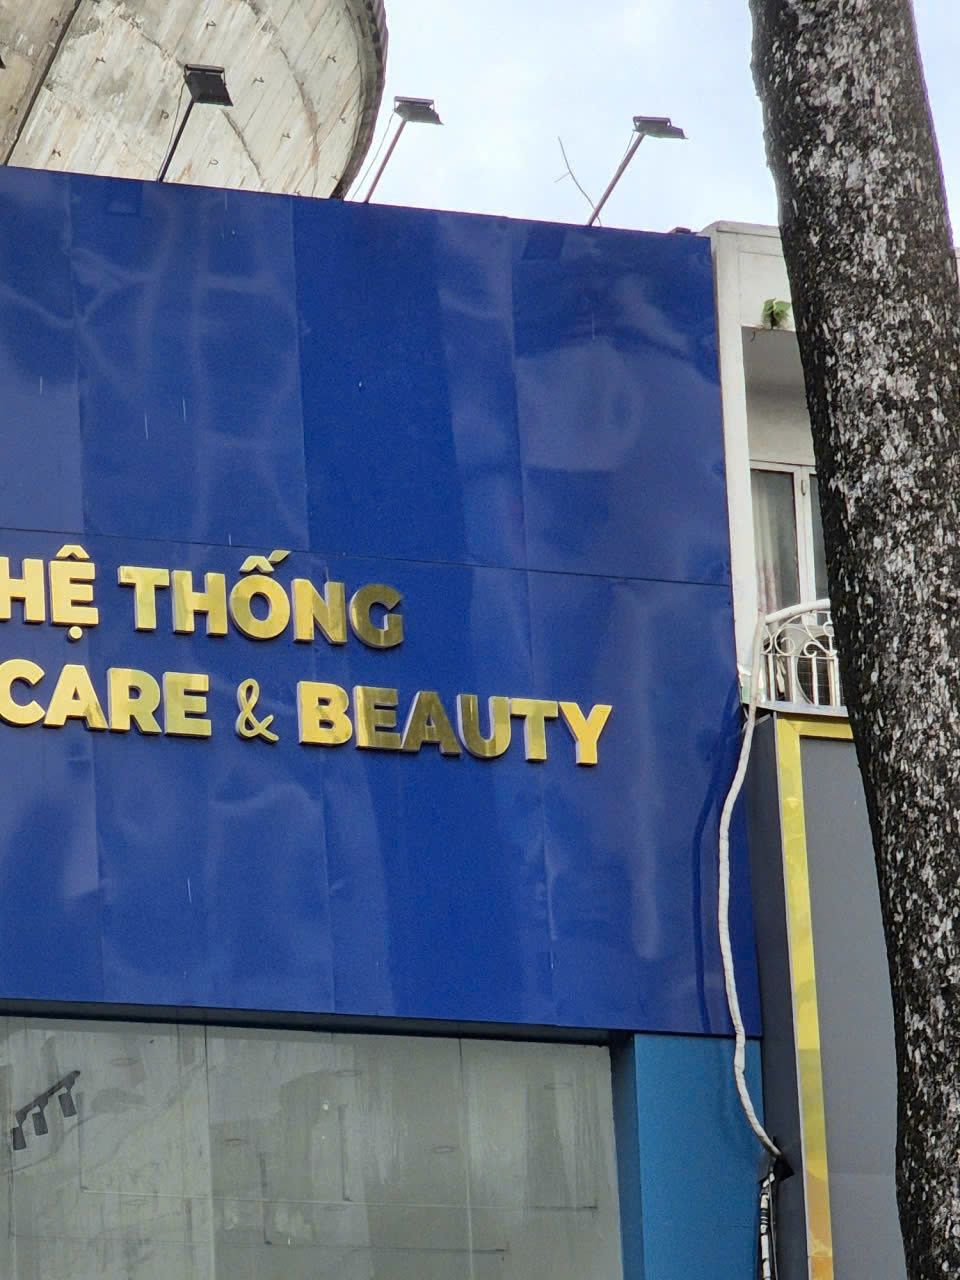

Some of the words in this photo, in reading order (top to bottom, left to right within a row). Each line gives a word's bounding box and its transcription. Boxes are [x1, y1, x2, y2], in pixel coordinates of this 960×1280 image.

[117, 549, 405, 649] THỐNG
[236, 678, 279, 743] &
[297, 680, 613, 766] BEAUTY
